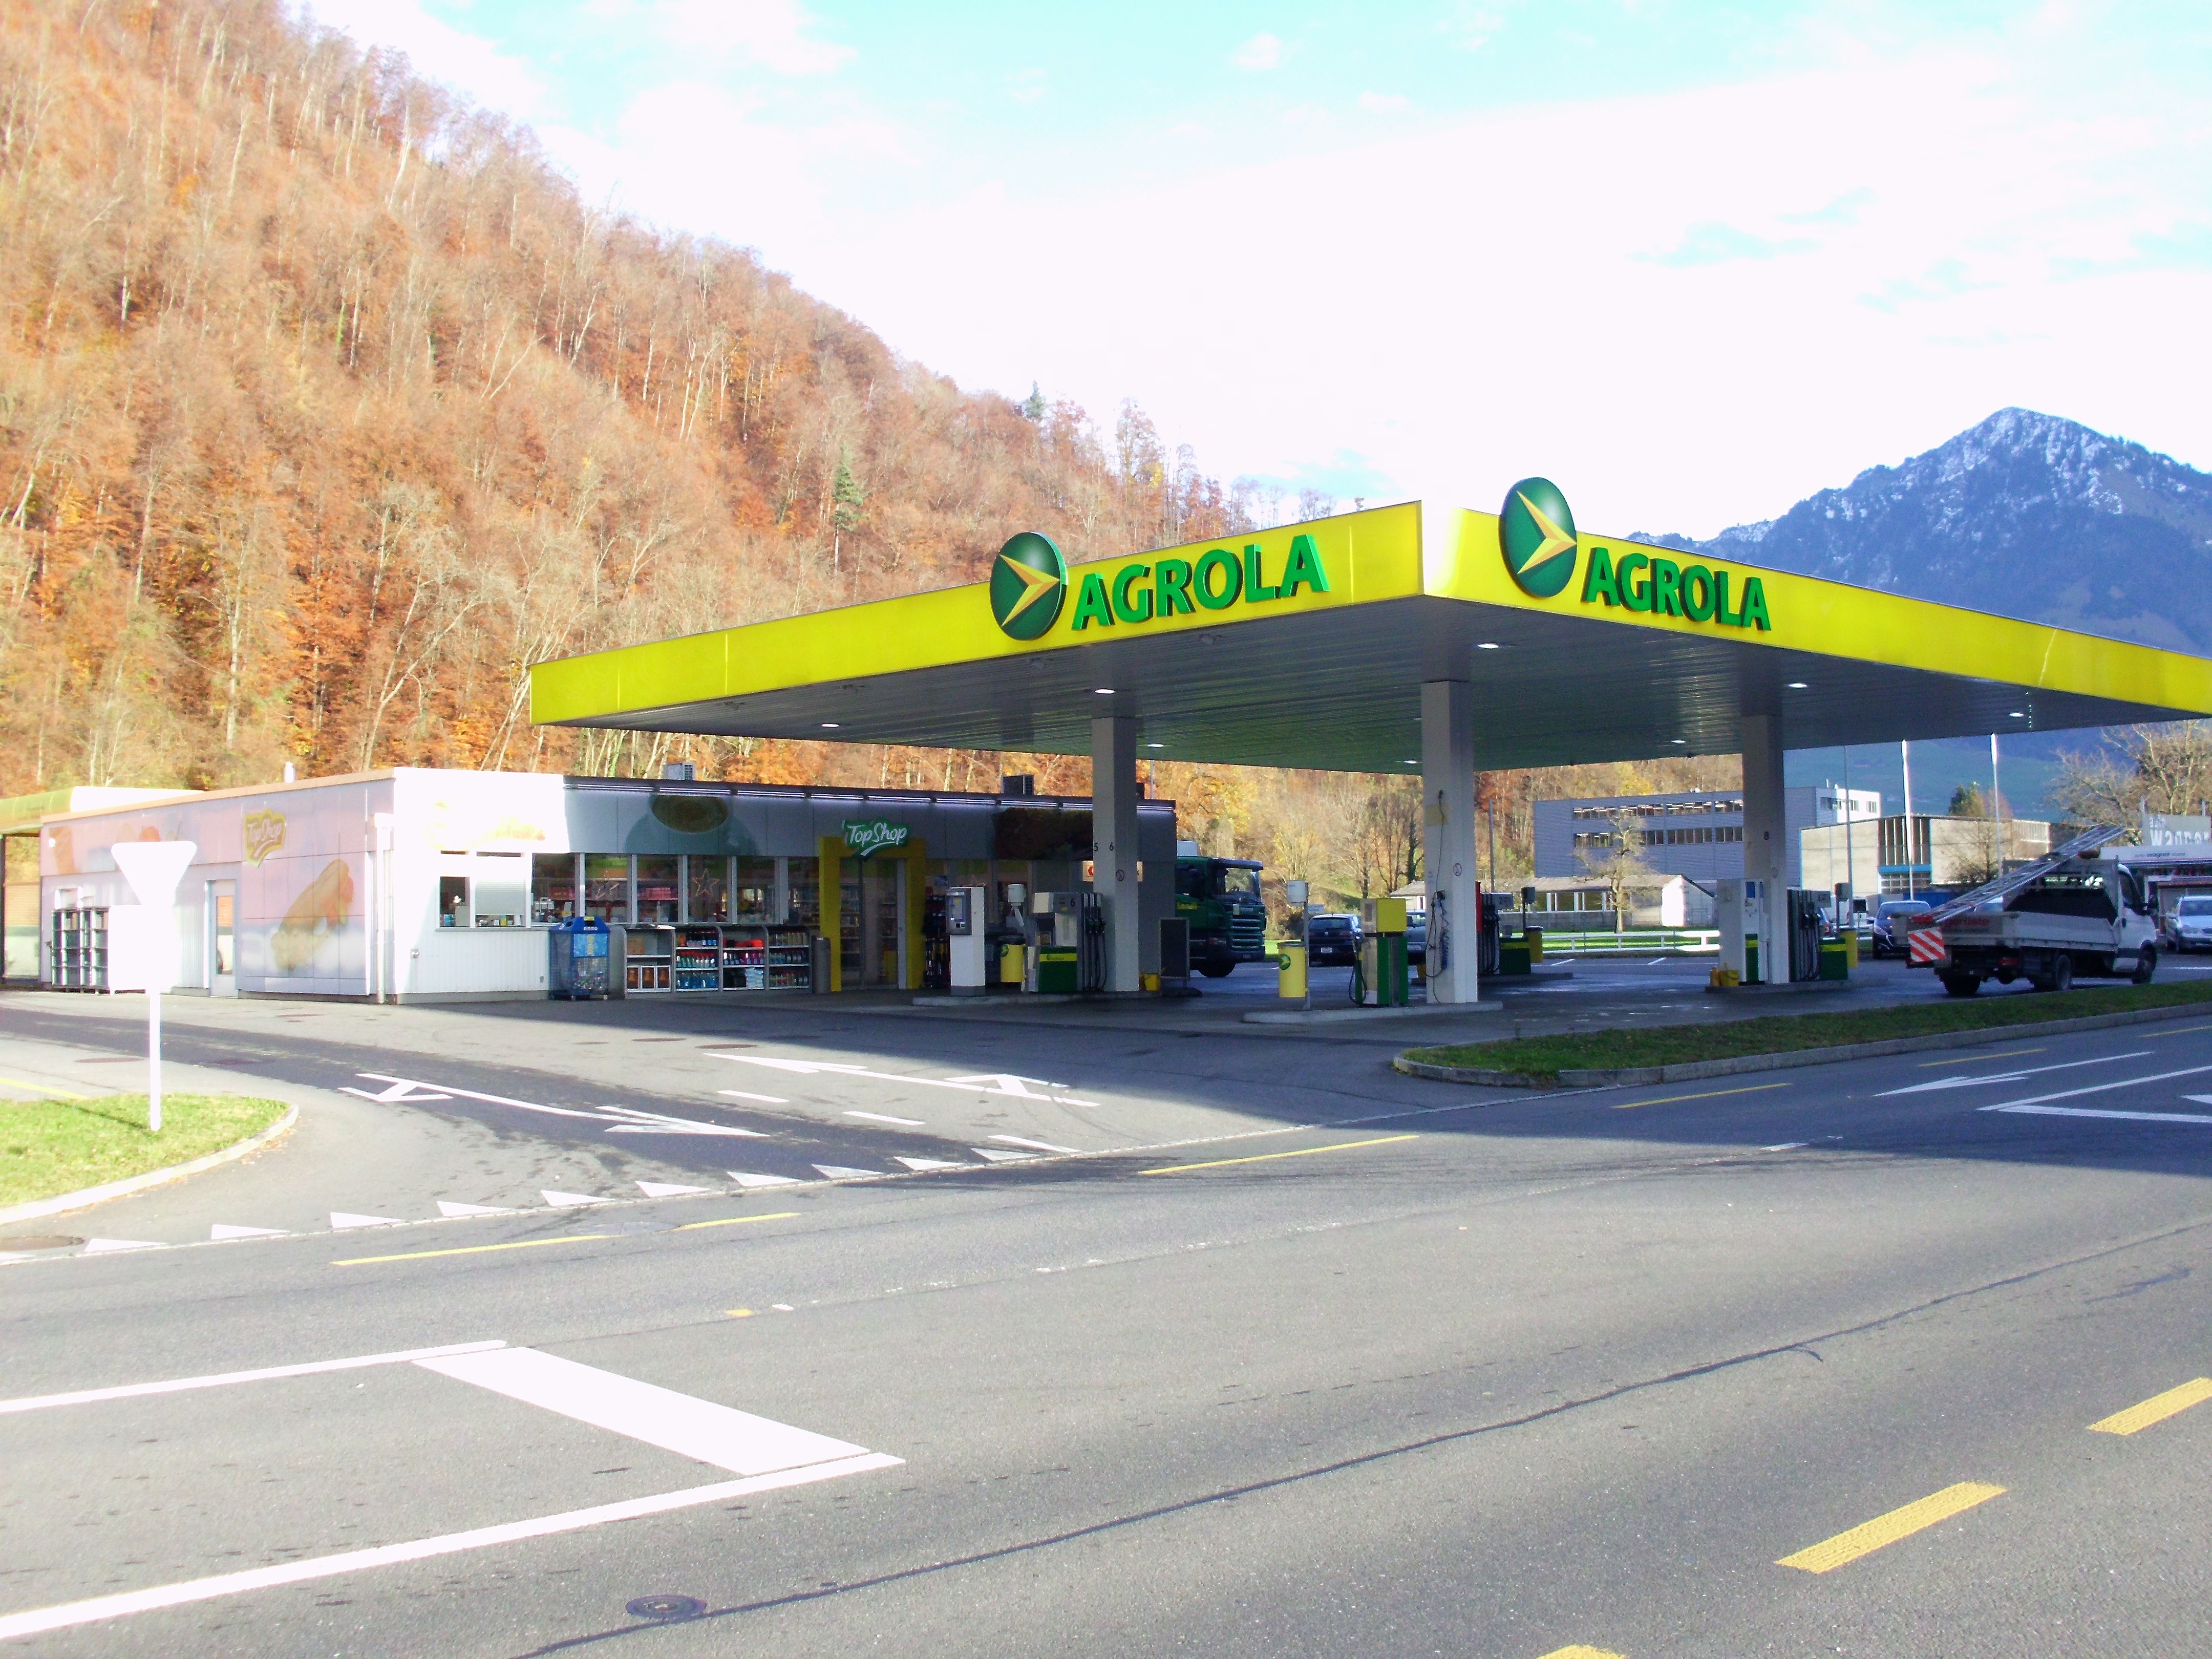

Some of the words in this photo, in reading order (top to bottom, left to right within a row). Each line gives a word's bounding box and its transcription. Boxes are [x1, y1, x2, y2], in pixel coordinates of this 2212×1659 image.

[1071, 534, 1330, 630] AGROLA
[1580, 547, 1771, 631] AGROLA
[247, 818, 282, 848] TopShop
[847, 822, 907, 847] TopShop
[1763, 831, 1770, 840] 8
[1093, 842, 1098, 852] 5
[1109, 842, 1114, 851] 6
[1070, 897, 1075, 907] 6
